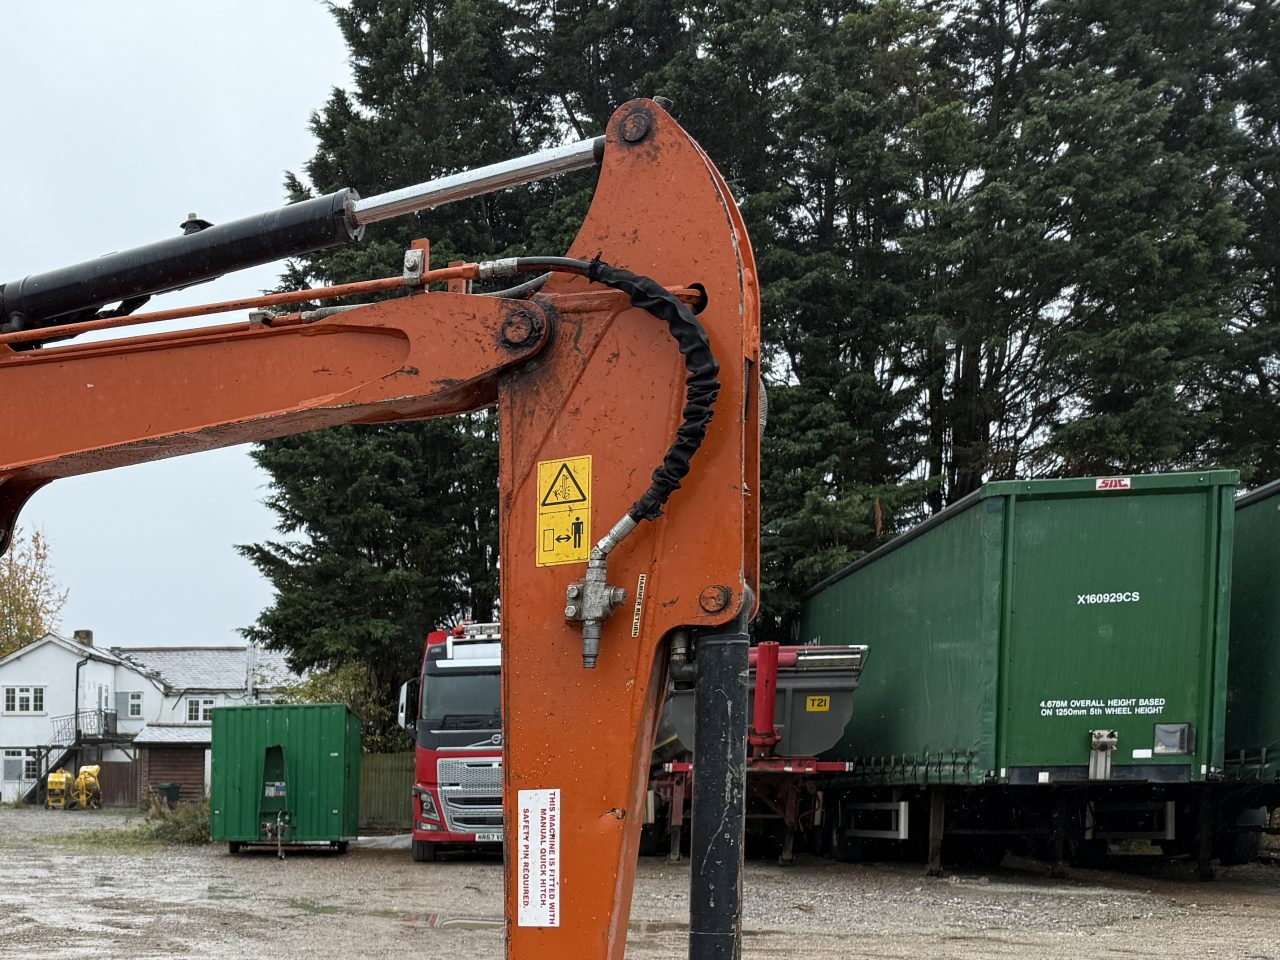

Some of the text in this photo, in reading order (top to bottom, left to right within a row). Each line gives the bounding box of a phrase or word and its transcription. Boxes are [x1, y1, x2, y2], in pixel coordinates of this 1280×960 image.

[1097, 479, 1129, 489] SDC
[1076, 591, 1140, 605] X160929CS
[633, 608, 641, 636] RETURN
[1039, 697, 1166, 708] 4.678M OVERALL HEIGHT BASED
[1040, 706, 1164, 716] ON 1250mm 5th WHEEL HEIGHT
[522, 808, 530, 909] SAFETY PIN REQUIRED.
[549, 857, 556, 867] IS
